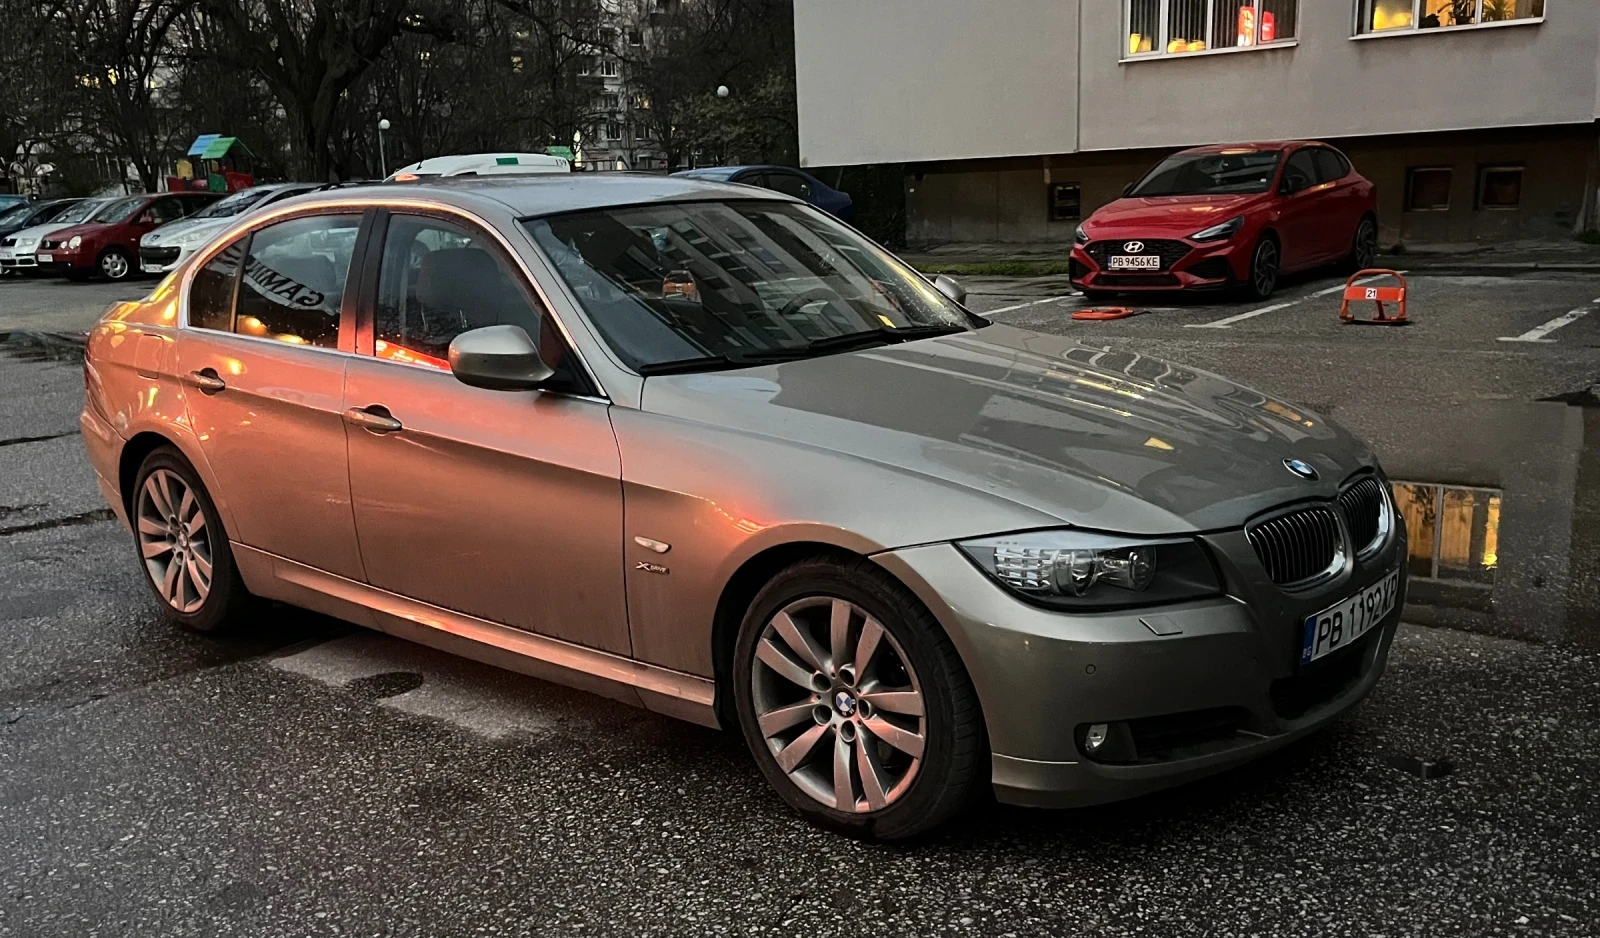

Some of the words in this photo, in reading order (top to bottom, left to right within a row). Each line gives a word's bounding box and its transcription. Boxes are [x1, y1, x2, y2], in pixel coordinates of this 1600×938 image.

[1112, 257, 1123, 267] PB
[1125, 257, 1145, 267] 9456
[1146, 257, 1158, 267] KE
[1367, 289, 1376, 298] 21
[1315, 611, 1342, 656] PB
[1349, 586, 1381, 638] 1192
[1381, 573, 1398, 615] XP
